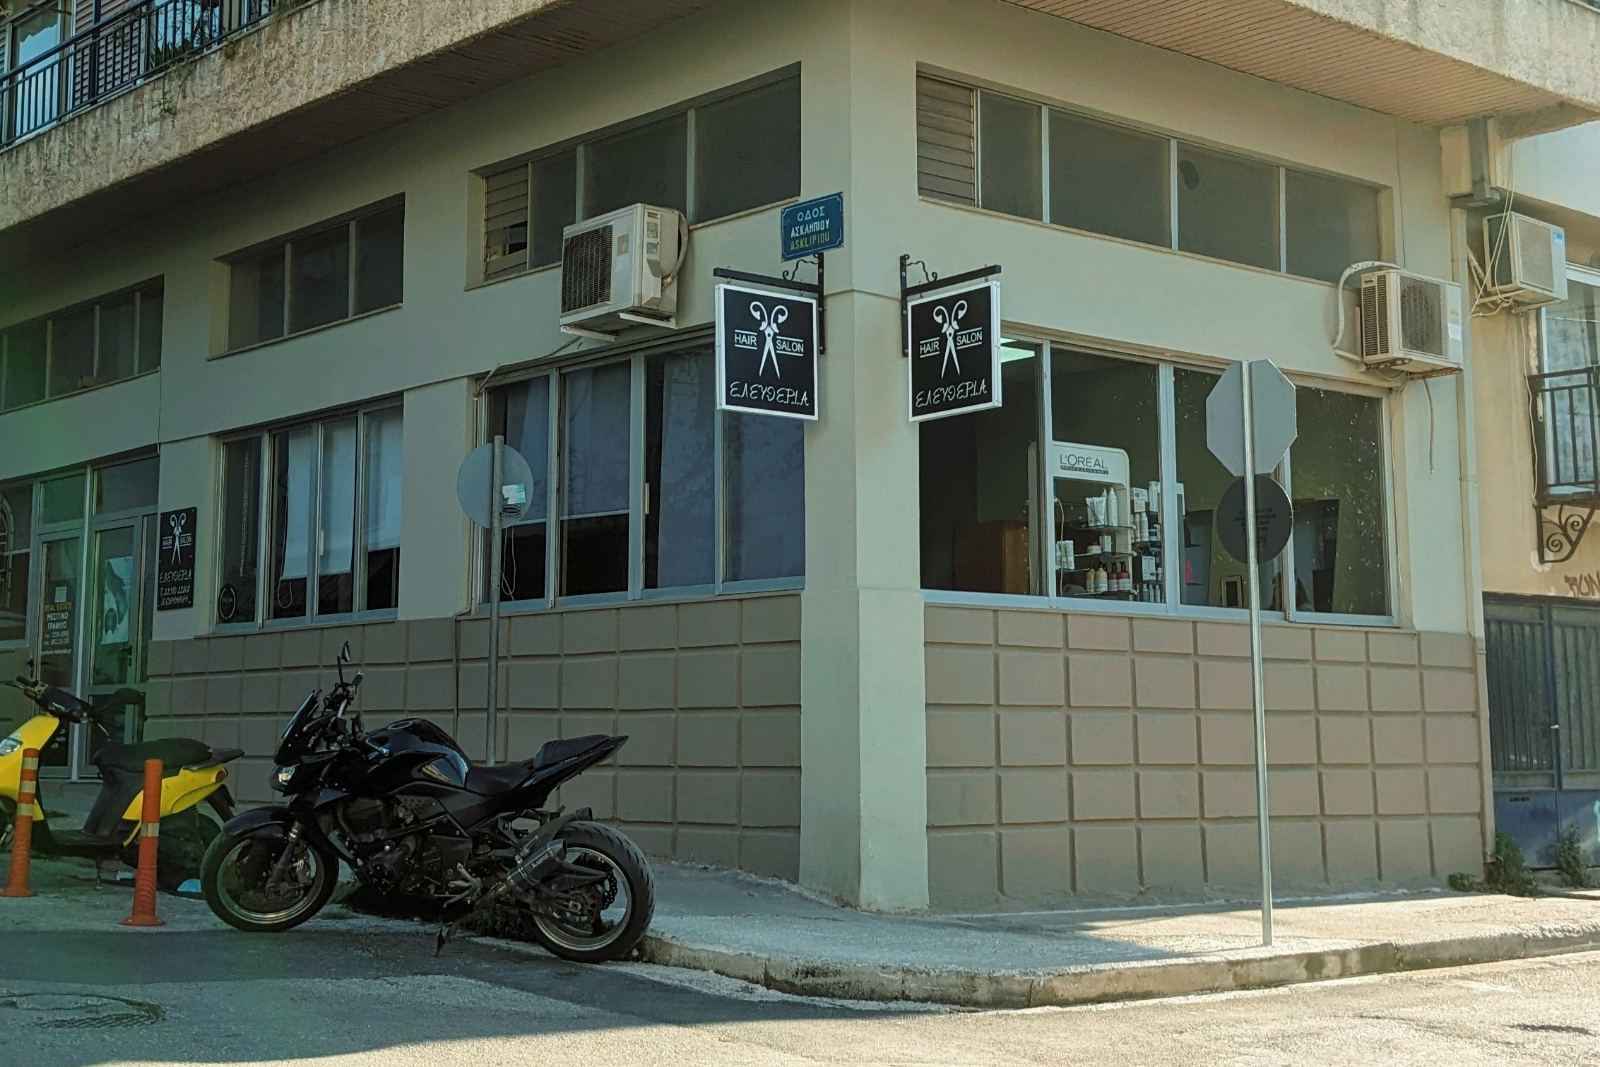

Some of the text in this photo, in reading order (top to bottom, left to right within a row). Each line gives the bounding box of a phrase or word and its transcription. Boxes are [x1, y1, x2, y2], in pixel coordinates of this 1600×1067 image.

[797, 206, 825, 222] ΟΔΟΣ
[791, 218, 830, 238] ΑΣΚΛΗΠΙΟΥ
[791, 232, 830, 251] ASKLIPIOU
[734, 332, 804, 353] HAIR SALON
[920, 331, 983, 354] HAIR SALON
[729, 381, 809, 407] ΕΛΕΥΘΕΡΙΑ
[915, 378, 988, 408] ΕΛΕΥΘΕΡΙΑ
